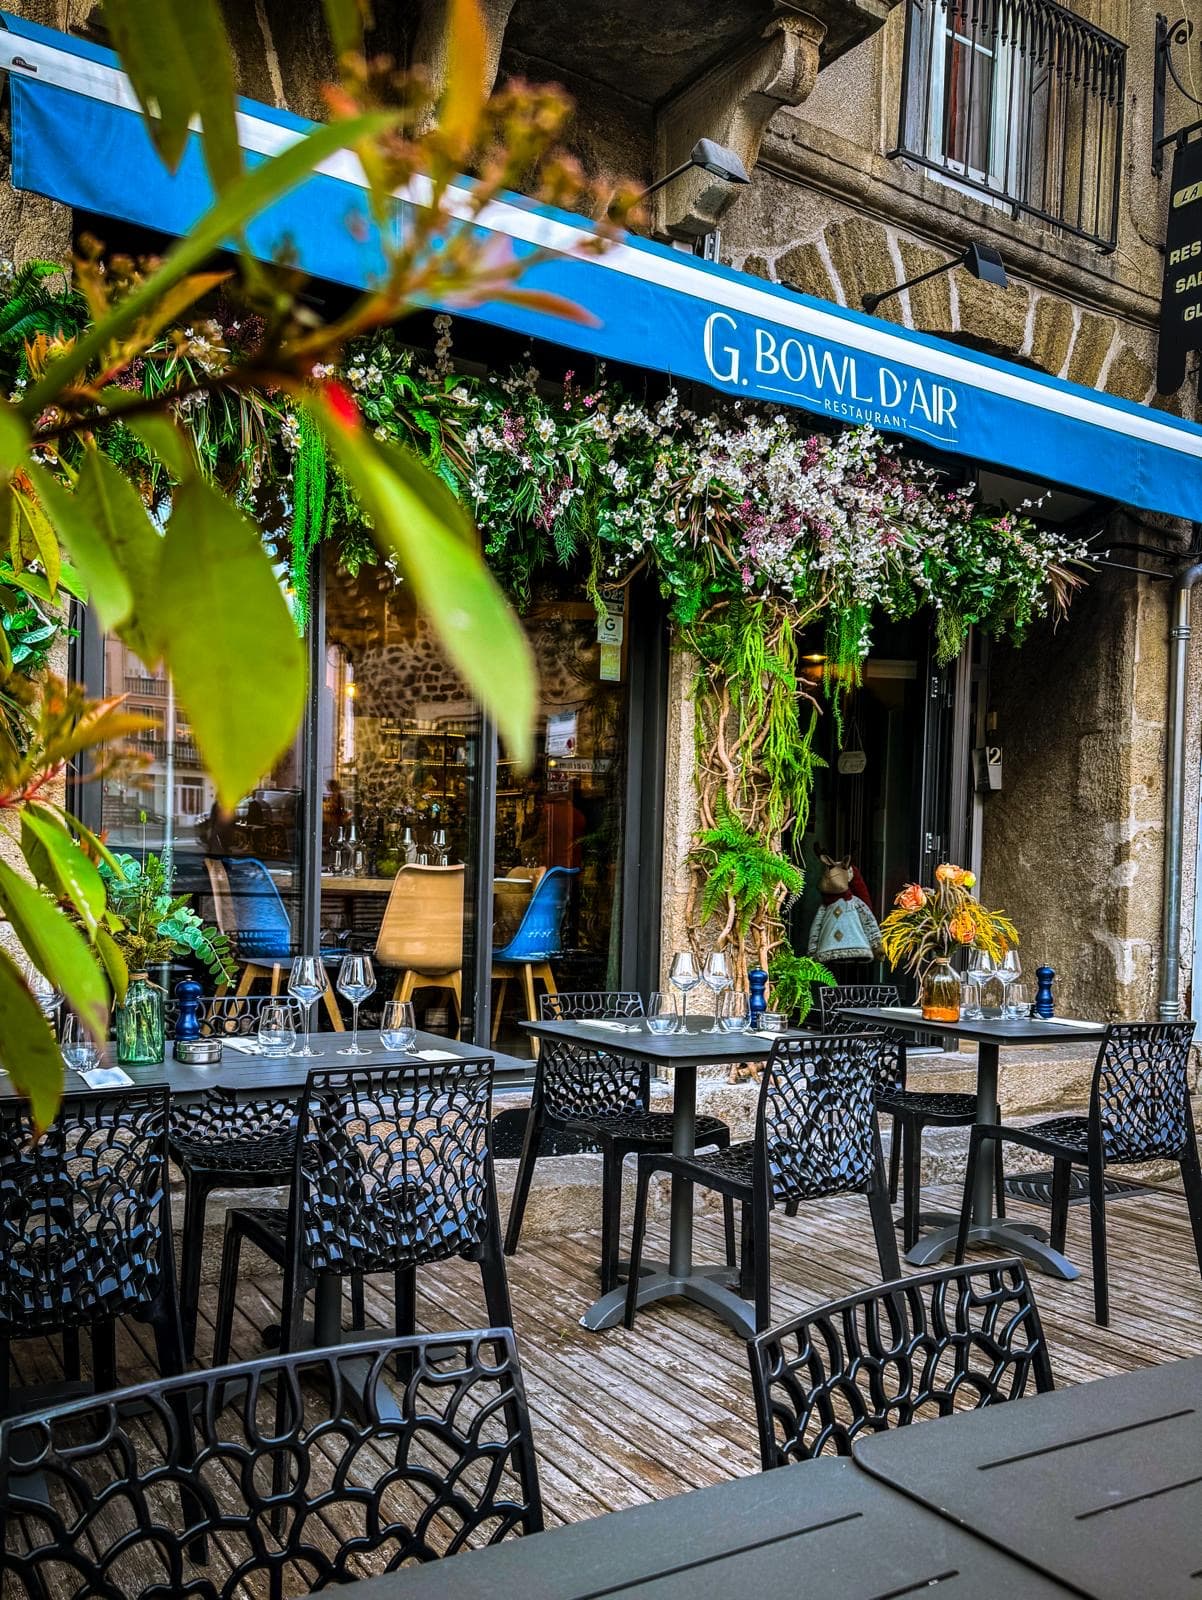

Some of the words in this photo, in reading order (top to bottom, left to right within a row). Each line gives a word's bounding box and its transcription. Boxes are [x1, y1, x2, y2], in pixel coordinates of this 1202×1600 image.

[1169, 240, 1202, 266] RES
[703, 312, 749, 386] G.
[755, 328, 873, 403] BOWL
[879, 367, 958, 429] D'AIR
[824, 398, 908, 429] RESTAURANT
